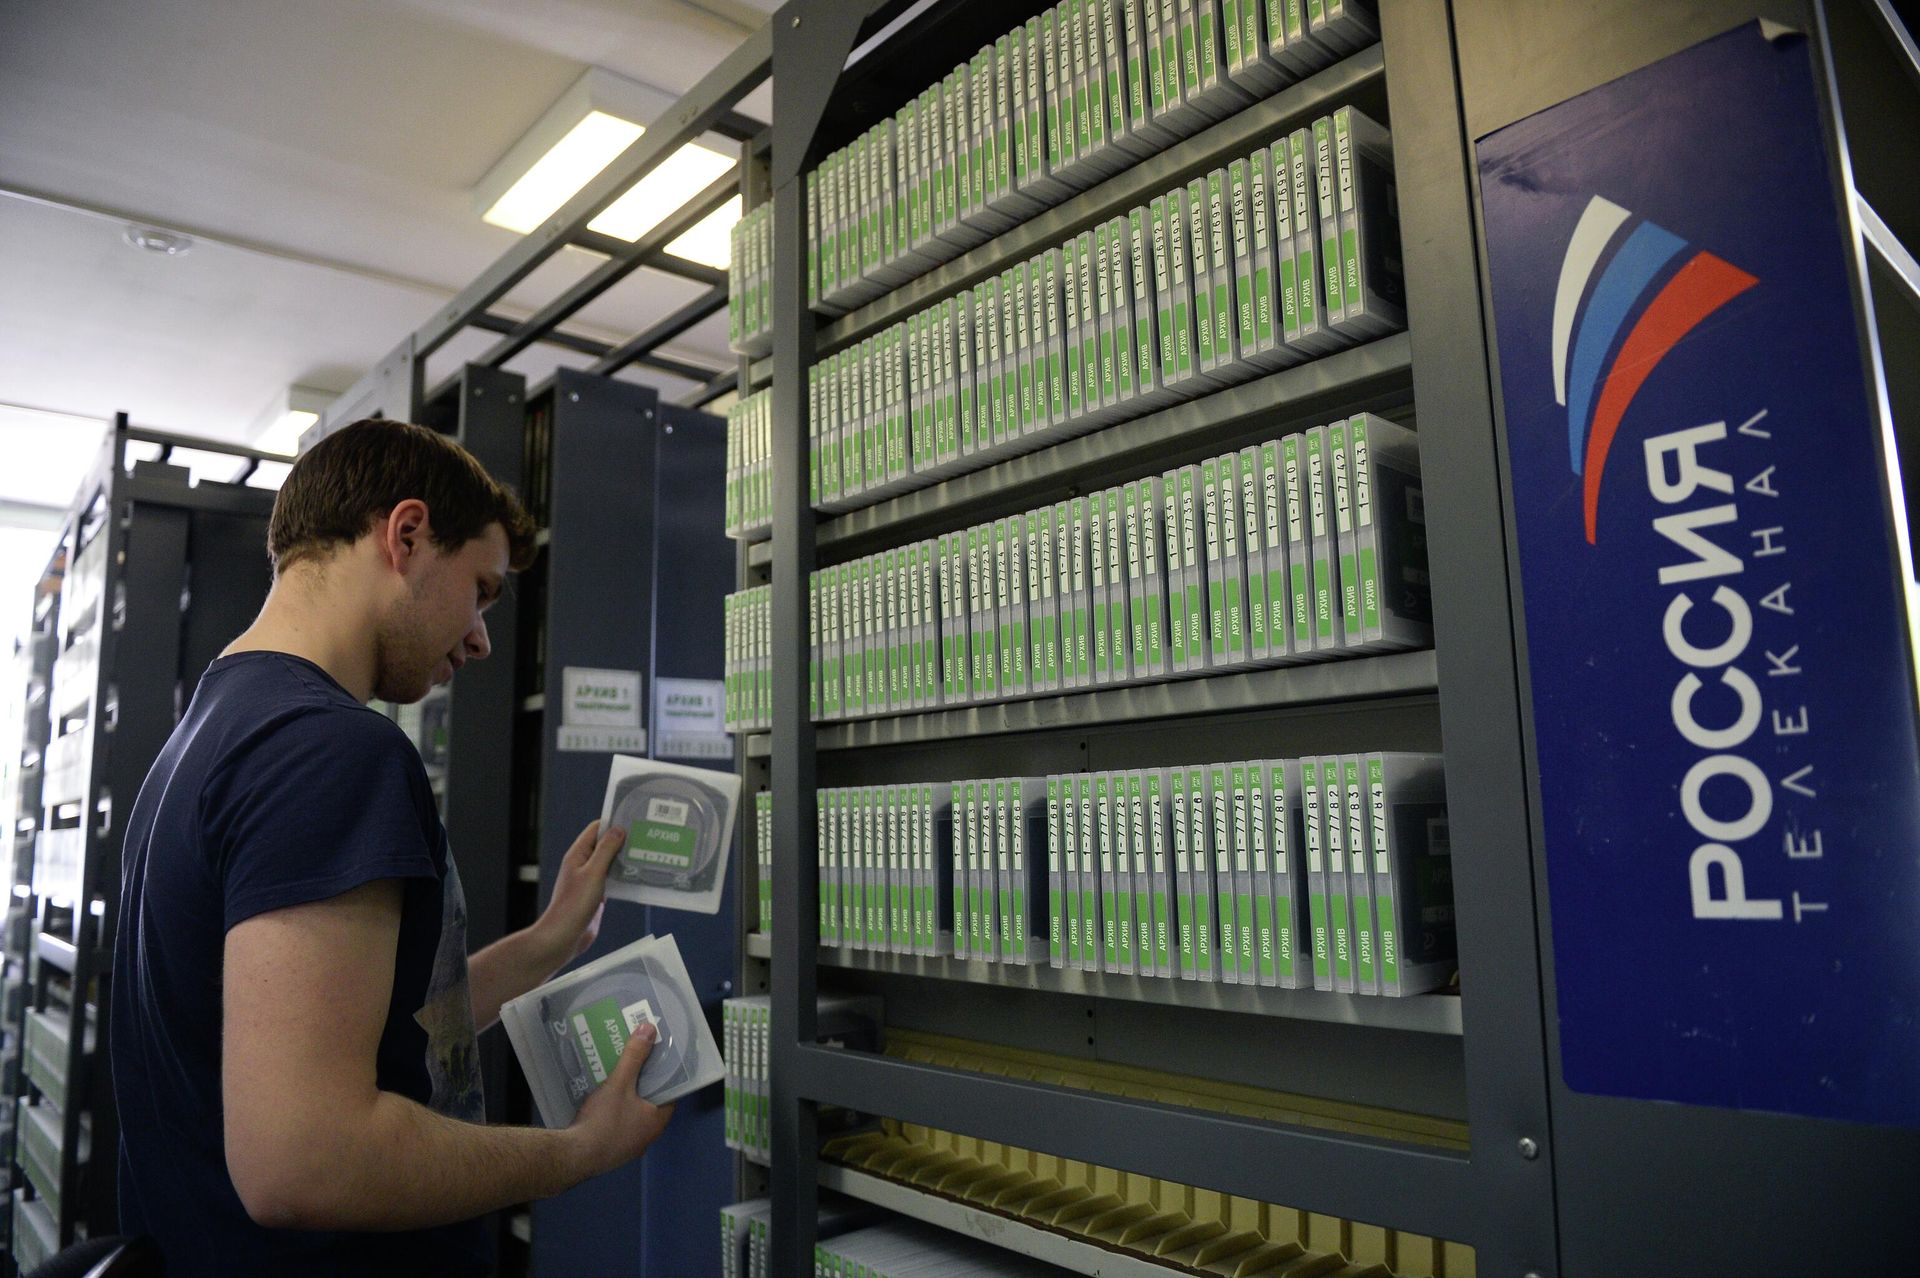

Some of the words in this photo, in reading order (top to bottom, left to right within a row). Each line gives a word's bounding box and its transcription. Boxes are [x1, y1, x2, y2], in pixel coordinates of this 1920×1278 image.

[1228, 25, 1237, 50] АРХИВ
[1246, 15, 1255, 41] АРХИВ
[1168, 60, 1176, 85] АРХИВ
[1185, 50, 1195, 74] АРХИВ
[1204, 38, 1213, 64] АРХИВ
[1153, 70, 1162, 95] АРХИВ
[1320, 145, 1330, 200] 1-7700
[1340, 136, 1352, 192] 1-7701
[1254, 182, 1265, 234] 1-7697
[1278, 169, 1288, 223] 1-7698
[1296, 162, 1307, 216] 1-7699
[1193, 208, 1204, 260] 1-7694
[1212, 201, 1223, 254] 1-7695
[1234, 190, 1245, 243] 1-7696
[1133, 237, 1144, 286] 1-7691
[1155, 226, 1166, 277] 1-7692
[1172, 217, 1183, 269] 1-7693
[1080, 264, 1090, 311] 1-7688
[1099, 250, 1107, 297] 1-7689
[1113, 243, 1122, 291] 1-7690
[1328, 267, 1338, 295] АРХИВ
[1347, 258, 1356, 287] АРХИВ
[1004, 293, 1012, 338] 1-7683
[1018, 288, 1027, 333] 1-7684
[1032, 285, 1042, 331] 1-7685
[1047, 276, 1057, 323] 1-7686
[1066, 271, 1076, 318] 1-7687
[1259, 296, 1268, 323] АРХИВ
[1285, 287, 1294, 315] АРХИВ
[1302, 279, 1311, 307] АРХИВ
[990, 304, 999, 349] 1-7682
[1201, 319, 1210, 345] АРХИВ
[1218, 312, 1227, 339] АРХИВ
[1242, 303, 1251, 330] АРХИВ
[1120, 352, 1129, 377] АРХИВ
[1141, 344, 1149, 370] АРХИВ
[1163, 335, 1172, 361] АРХИВ
[1179, 330, 1187, 356] АРХИВ
[1104, 357, 1112, 382] АРХИВ
[1287, 467, 1300, 523] 1-7740
[1311, 460, 1325, 517] 1-7741
[1336, 454, 1349, 512] 1-7742
[1357, 448, 1369, 508] 1-7743
[1184, 497, 1195, 551] 1-7735
[1206, 491, 1218, 545] 1-7736
[1223, 488, 1236, 542] 1-7737
[1244, 480, 1258, 535] 1-7738
[1266, 474, 1278, 530] 1-7739
[1058, 527, 1068, 575] 1-7728
[1074, 526, 1082, 575] 1-7729
[1092, 521, 1102, 571] 1-7730
[1108, 518, 1118, 568] 1-7731
[1128, 514, 1138, 565] 1-7732
[1144, 507, 1154, 560] 1-7733
[1166, 505, 1177, 557] 1-7734
[970, 553, 979, 599] 1-7722
[982, 550, 992, 596] 1-7723
[998, 551, 1007, 599] 1-7724
[1012, 543, 1021, 590] 1-7725
[1029, 540, 1038, 588] 1-7726
[1042, 532, 1051, 580] 1-7727
[1271, 601, 1281, 630] АРХИВ
[1296, 594, 1305, 624] АРХИВ
[1318, 590, 1328, 620] АРХИВ
[1346, 586, 1356, 617] АРХИВ
[1365, 579, 1375, 611] АРХИВ
[1135, 624, 1143, 651] АРХИВ
[1150, 622, 1158, 649] АРХИВ
[1174, 620, 1182, 648] АРХИВ
[1190, 613, 1200, 641] АРХИВ
[1213, 610, 1222, 638] АРХИВ
[1230, 607, 1239, 635] АРХИВ
[1253, 603, 1263, 633] АРХИВ
[1015, 647, 1023, 672] АРХИВ
[1064, 638, 1072, 663] АРХИВ
[1078, 635, 1086, 661] АРХИВ
[1097, 631, 1105, 657] АРХИВ
[1114, 629, 1122, 656] АРХИВ
[1643, 420, 1783, 920] РОССИЯ
[1737, 408, 1829, 923] ТЕЛЕКАНАЛ
[576, 685, 618, 698] АРХИВ
[646, 828, 680, 842] АРХИВ
[1050, 804, 1058, 854] 1-7768
[1066, 803, 1074, 854] 1-7769
[1083, 803, 1091, 855] 1-7770
[1099, 803, 1109, 855] 1-7771
[1117, 802, 1126, 856] 1-7772
[1134, 801, 1143, 855] 1-7773
[1154, 801, 1163, 856] 1-7774
[1176, 798, 1186, 854] 1-7775
[1194, 797, 1203, 854] 1-7776
[1216, 796, 1225, 853] 1-7777
[1236, 794, 1245, 853] 1-7778
[1254, 794, 1263, 853] 1-7779
[1275, 795, 1284, 854] 1-7780
[1309, 790, 1319, 852] 1-7781
[1330, 791, 1340, 852] 1-7782
[1350, 792, 1360, 854] 1-7783
[1374, 790, 1384, 854] 1-7784
[1052, 917, 1060, 943] АРХИВ
[1070, 919, 1078, 945] АРХИВ
[1085, 919, 1094, 946] АРХИВ
[1106, 921, 1115, 948] АРХИВ
[1121, 921, 1129, 948] АРХИВ
[1140, 923, 1149, 951] АРХИВ
[1158, 922, 1167, 951] АРХИВ
[1182, 925, 1191, 953] АРХИВ
[1199, 925, 1208, 954] АРХИВ
[1223, 924, 1233, 954] АРХИВ
[1242, 926, 1251, 956] АРХИВ
[1261, 928, 1270, 959] АРХИВ
[1281, 928, 1290, 959] АРХИВ
[1316, 928, 1325, 959] АРХИВ
[1337, 928, 1347, 960] АРХИВ
[1360, 931, 1370, 963] АРХИВ
[1384, 931, 1394, 964] АРХИВ
